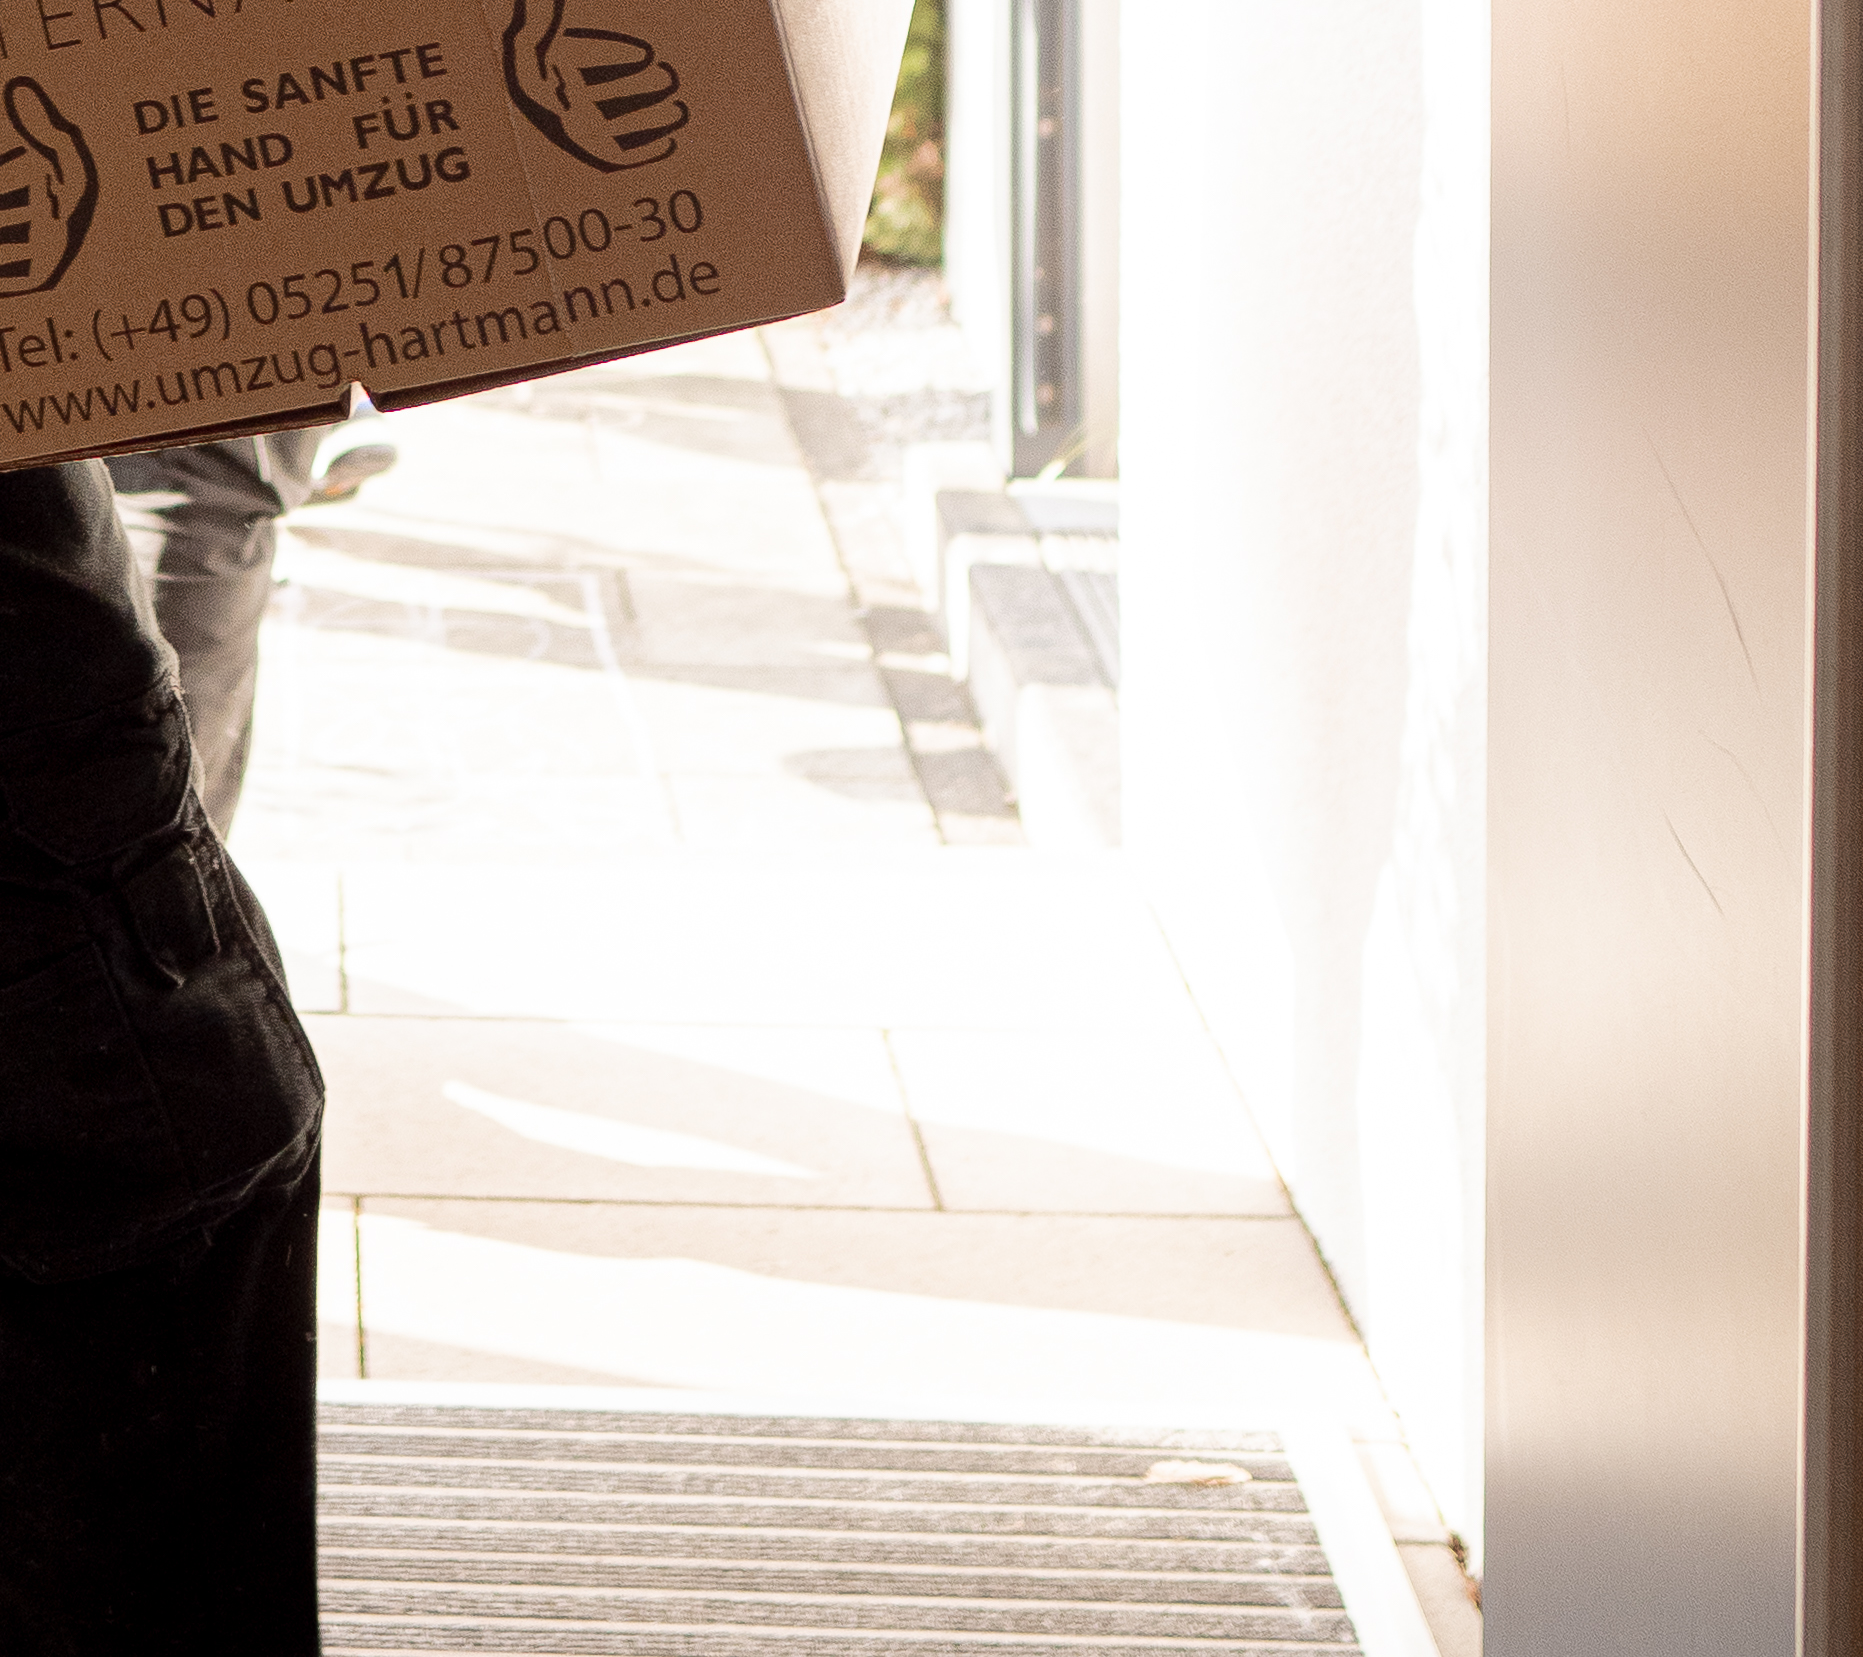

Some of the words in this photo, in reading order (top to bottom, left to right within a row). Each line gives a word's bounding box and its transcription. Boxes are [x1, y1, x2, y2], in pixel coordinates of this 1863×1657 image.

[133, 87, 218, 135] DIE
[241, 42, 447, 114] SANFTE
[146, 133, 294, 189] HAND
[353, 92, 460, 149] FÜR
[158, 189, 262, 238] DEN
[281, 146, 471, 214] UMZUG
[1, 254, 720, 435] www.umzug-hartmann.de
[92, 288, 232, 361] (+49)
